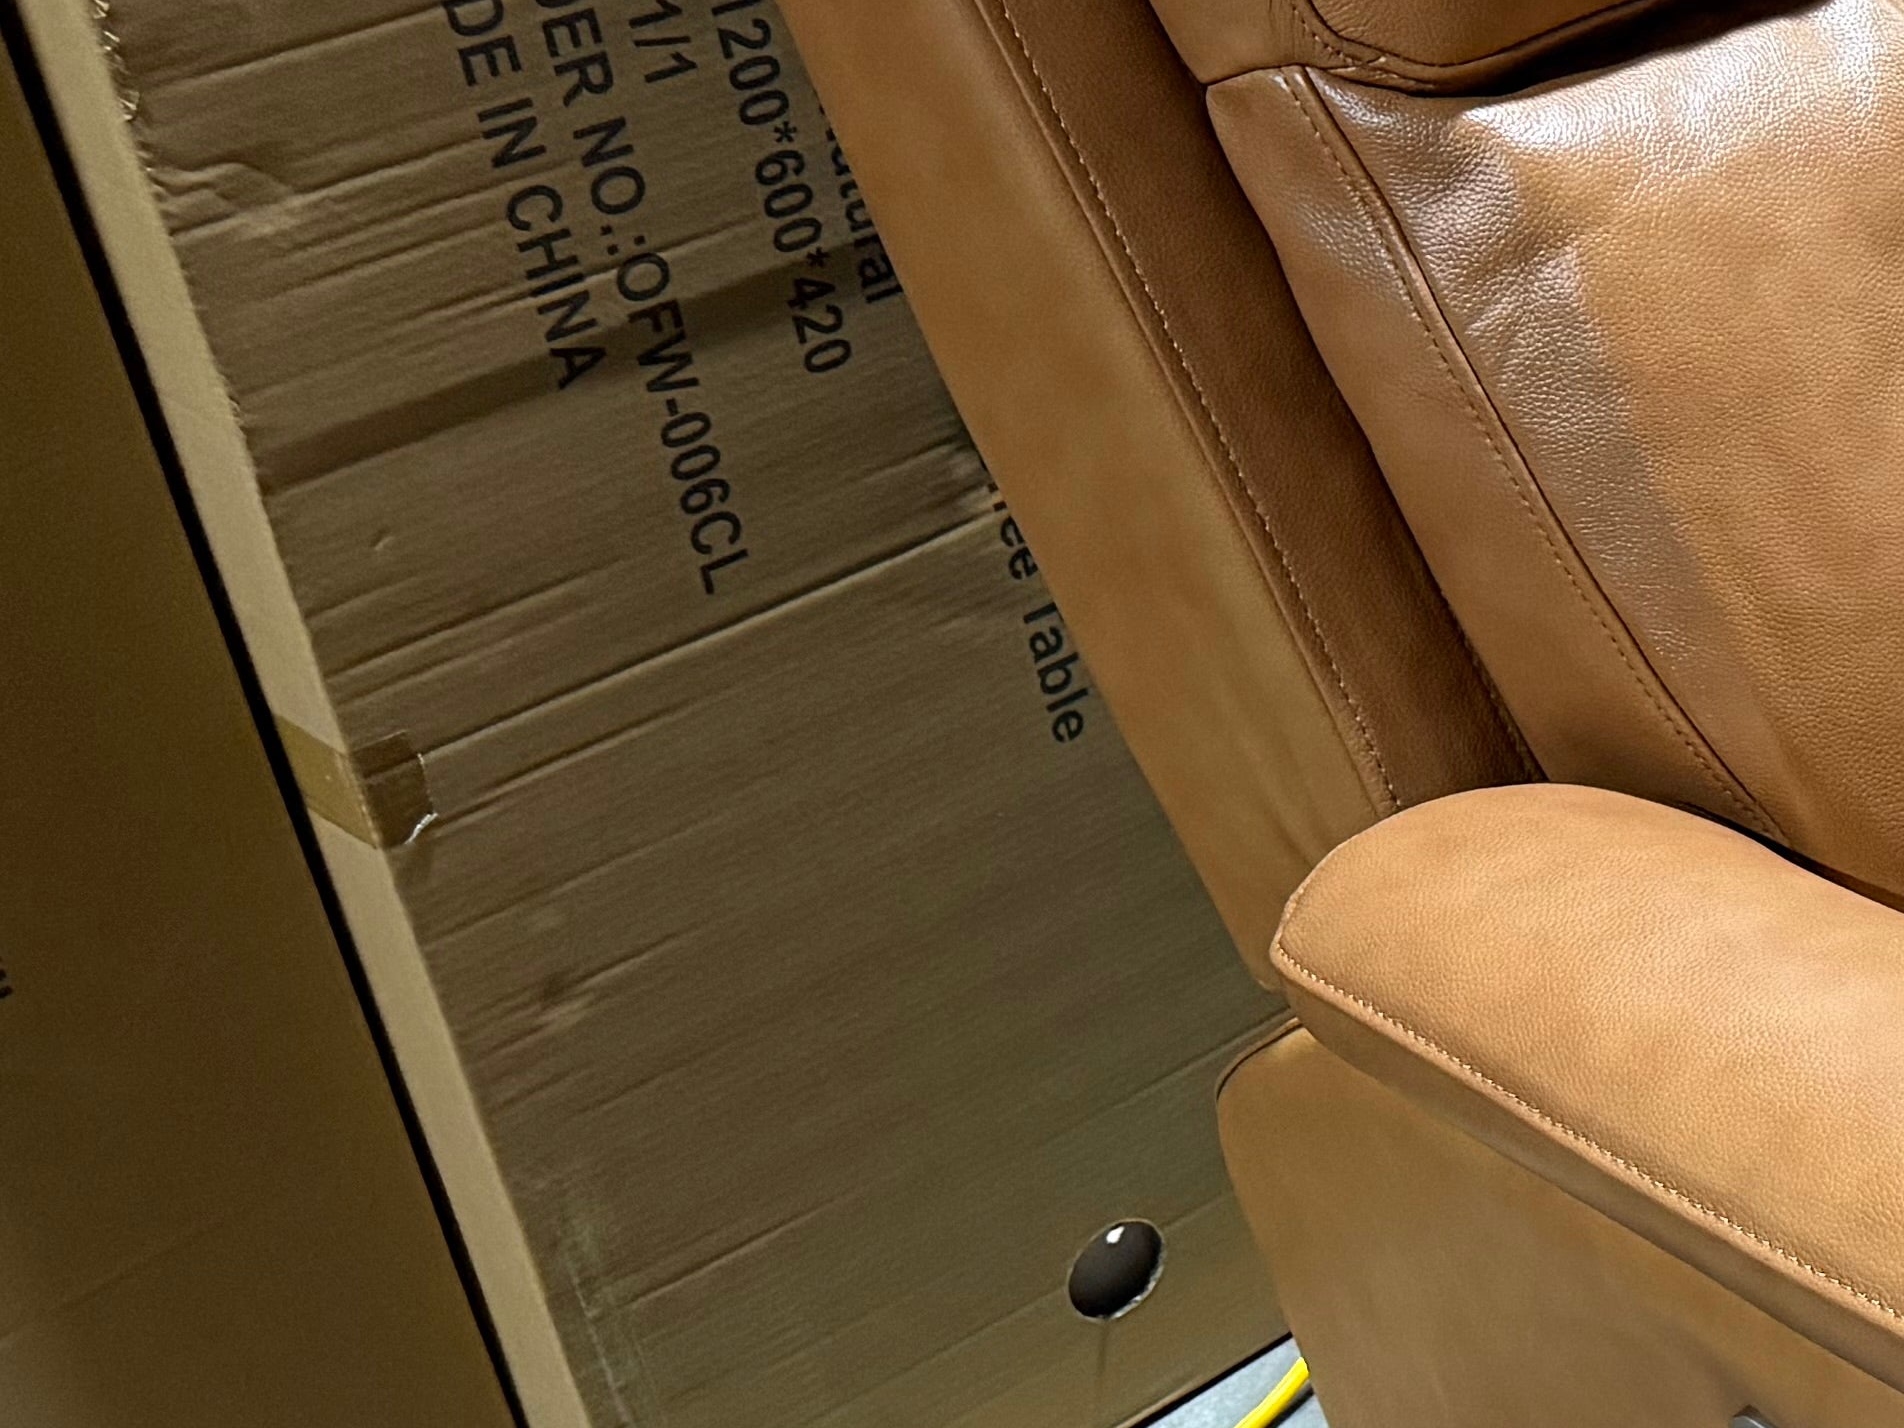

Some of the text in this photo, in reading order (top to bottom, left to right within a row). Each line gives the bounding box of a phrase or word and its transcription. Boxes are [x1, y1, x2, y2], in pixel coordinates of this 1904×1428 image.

[478, 100, 545, 169] IN
[506, 186, 610, 392] CHINA
[1021, 600, 1087, 743] Table
